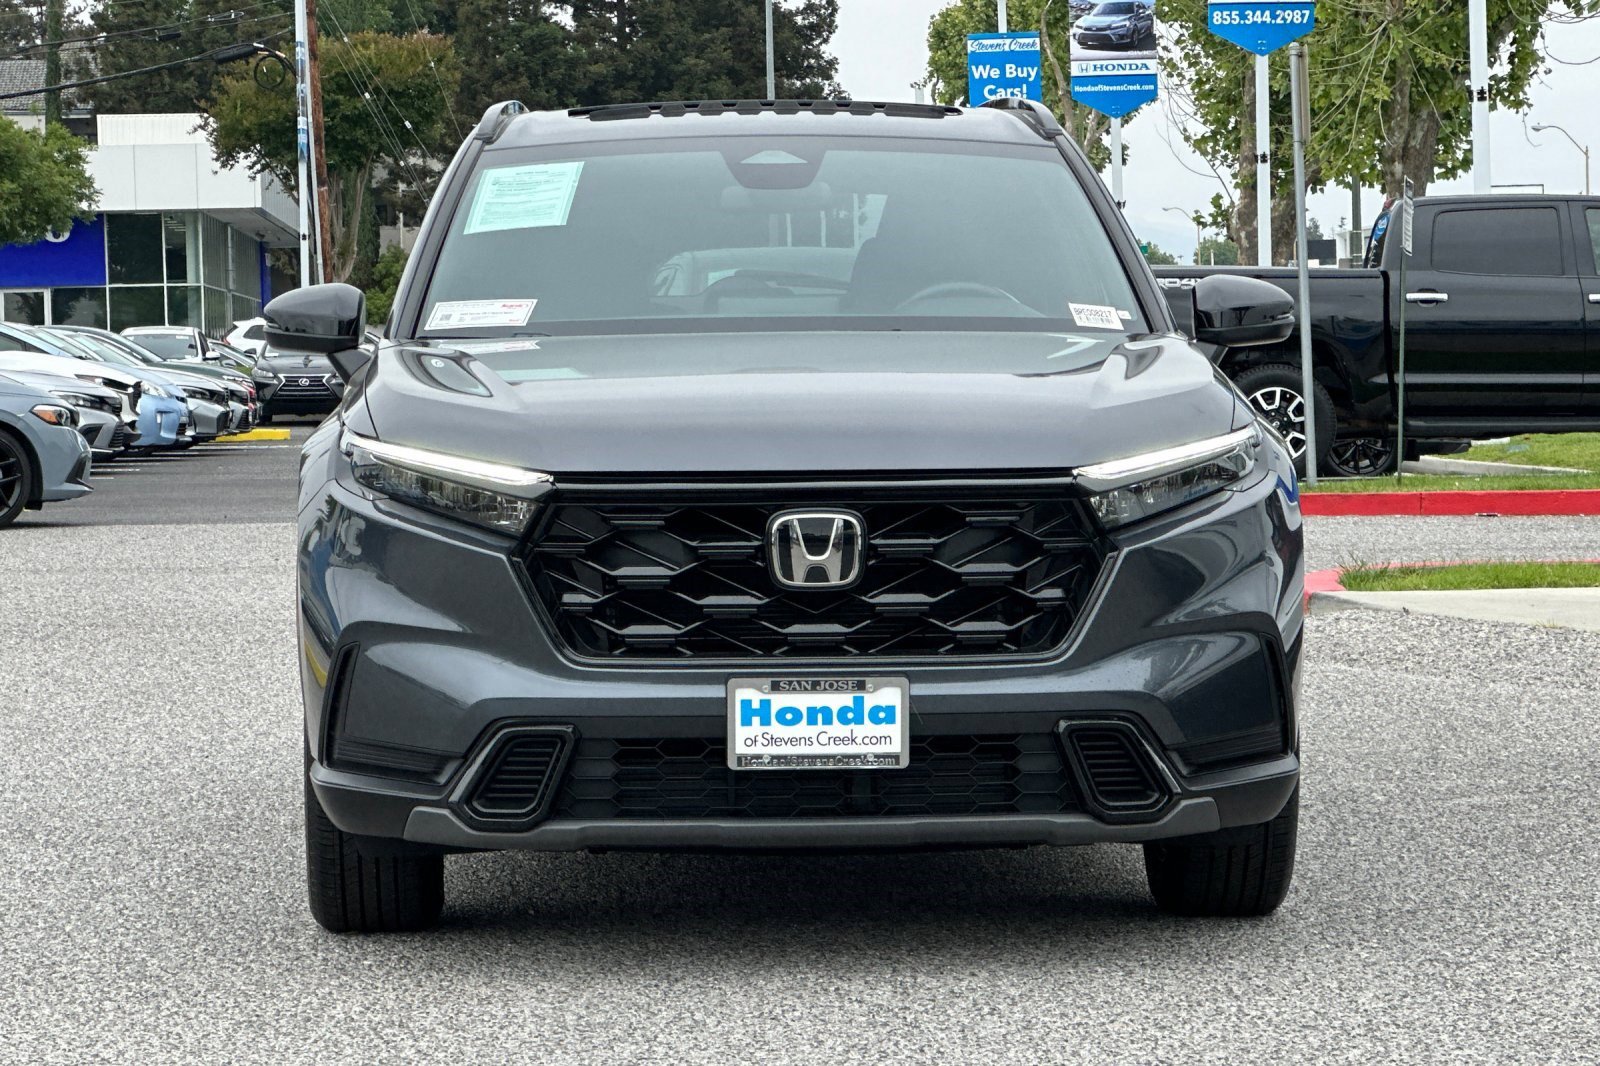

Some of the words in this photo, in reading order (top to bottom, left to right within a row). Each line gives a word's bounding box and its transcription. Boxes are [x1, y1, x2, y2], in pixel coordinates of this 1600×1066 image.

[1213, 10, 1310, 24] 855.344.2987
[1009, 38, 1038, 51] Creek
[971, 65, 1000, 79] We
[1005, 63, 1038, 81] Buy
[1092, 63, 1150, 71] HONDA
[983, 84, 1027, 99] Cars!
[1074, 84, 1154, 92] HondaofStevensCreek.com
[779, 680, 812, 691] SAN
[816, 680, 858, 691] JOSE
[740, 695, 896, 727] Honda
[744, 735, 758, 748] of
[761, 732, 814, 747] Stevens
[816, 728, 892, 747] Creek.com
